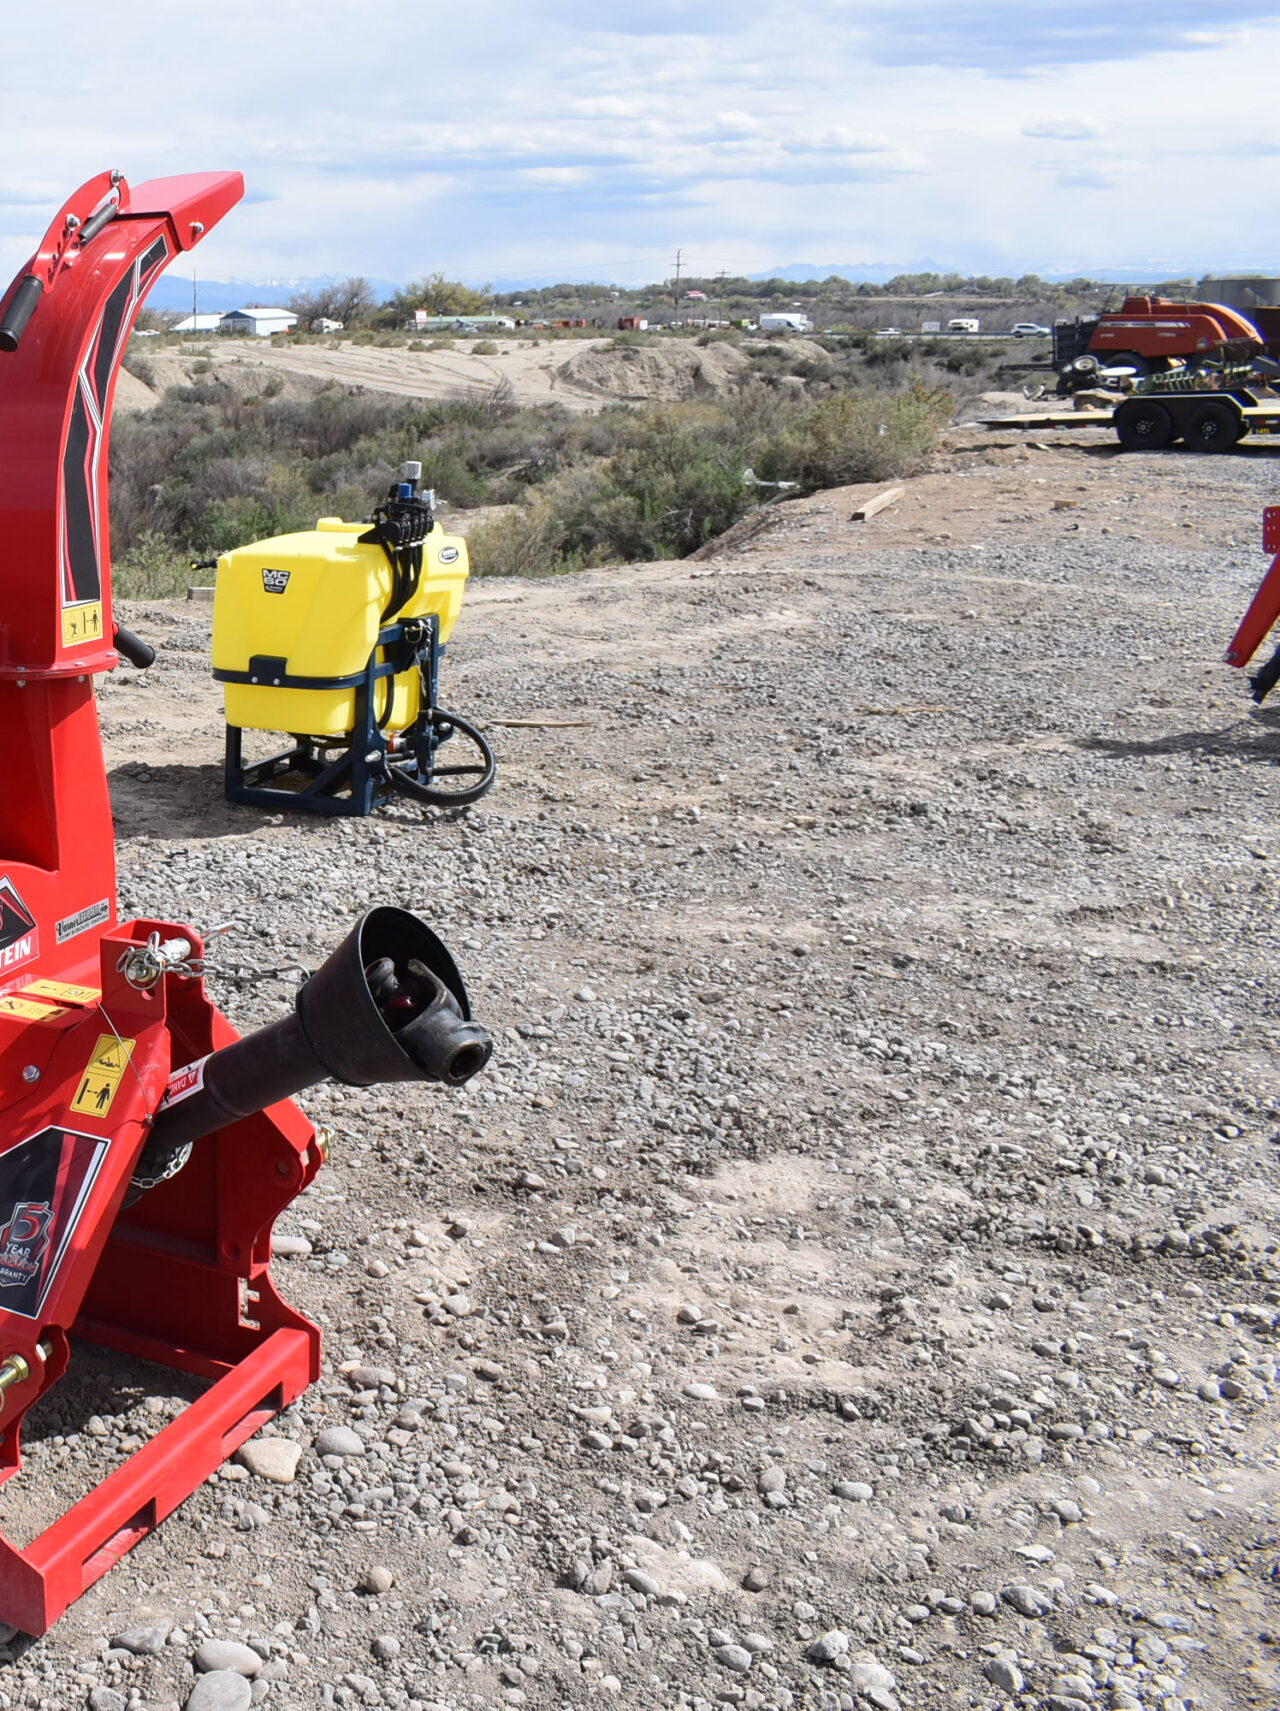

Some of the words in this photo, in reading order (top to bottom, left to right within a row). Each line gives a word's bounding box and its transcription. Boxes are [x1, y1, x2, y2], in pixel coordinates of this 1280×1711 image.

[263, 569, 289, 579] MC
[11, 1202, 46, 1241] 5
[6, 1241, 31, 1258] YEAR
